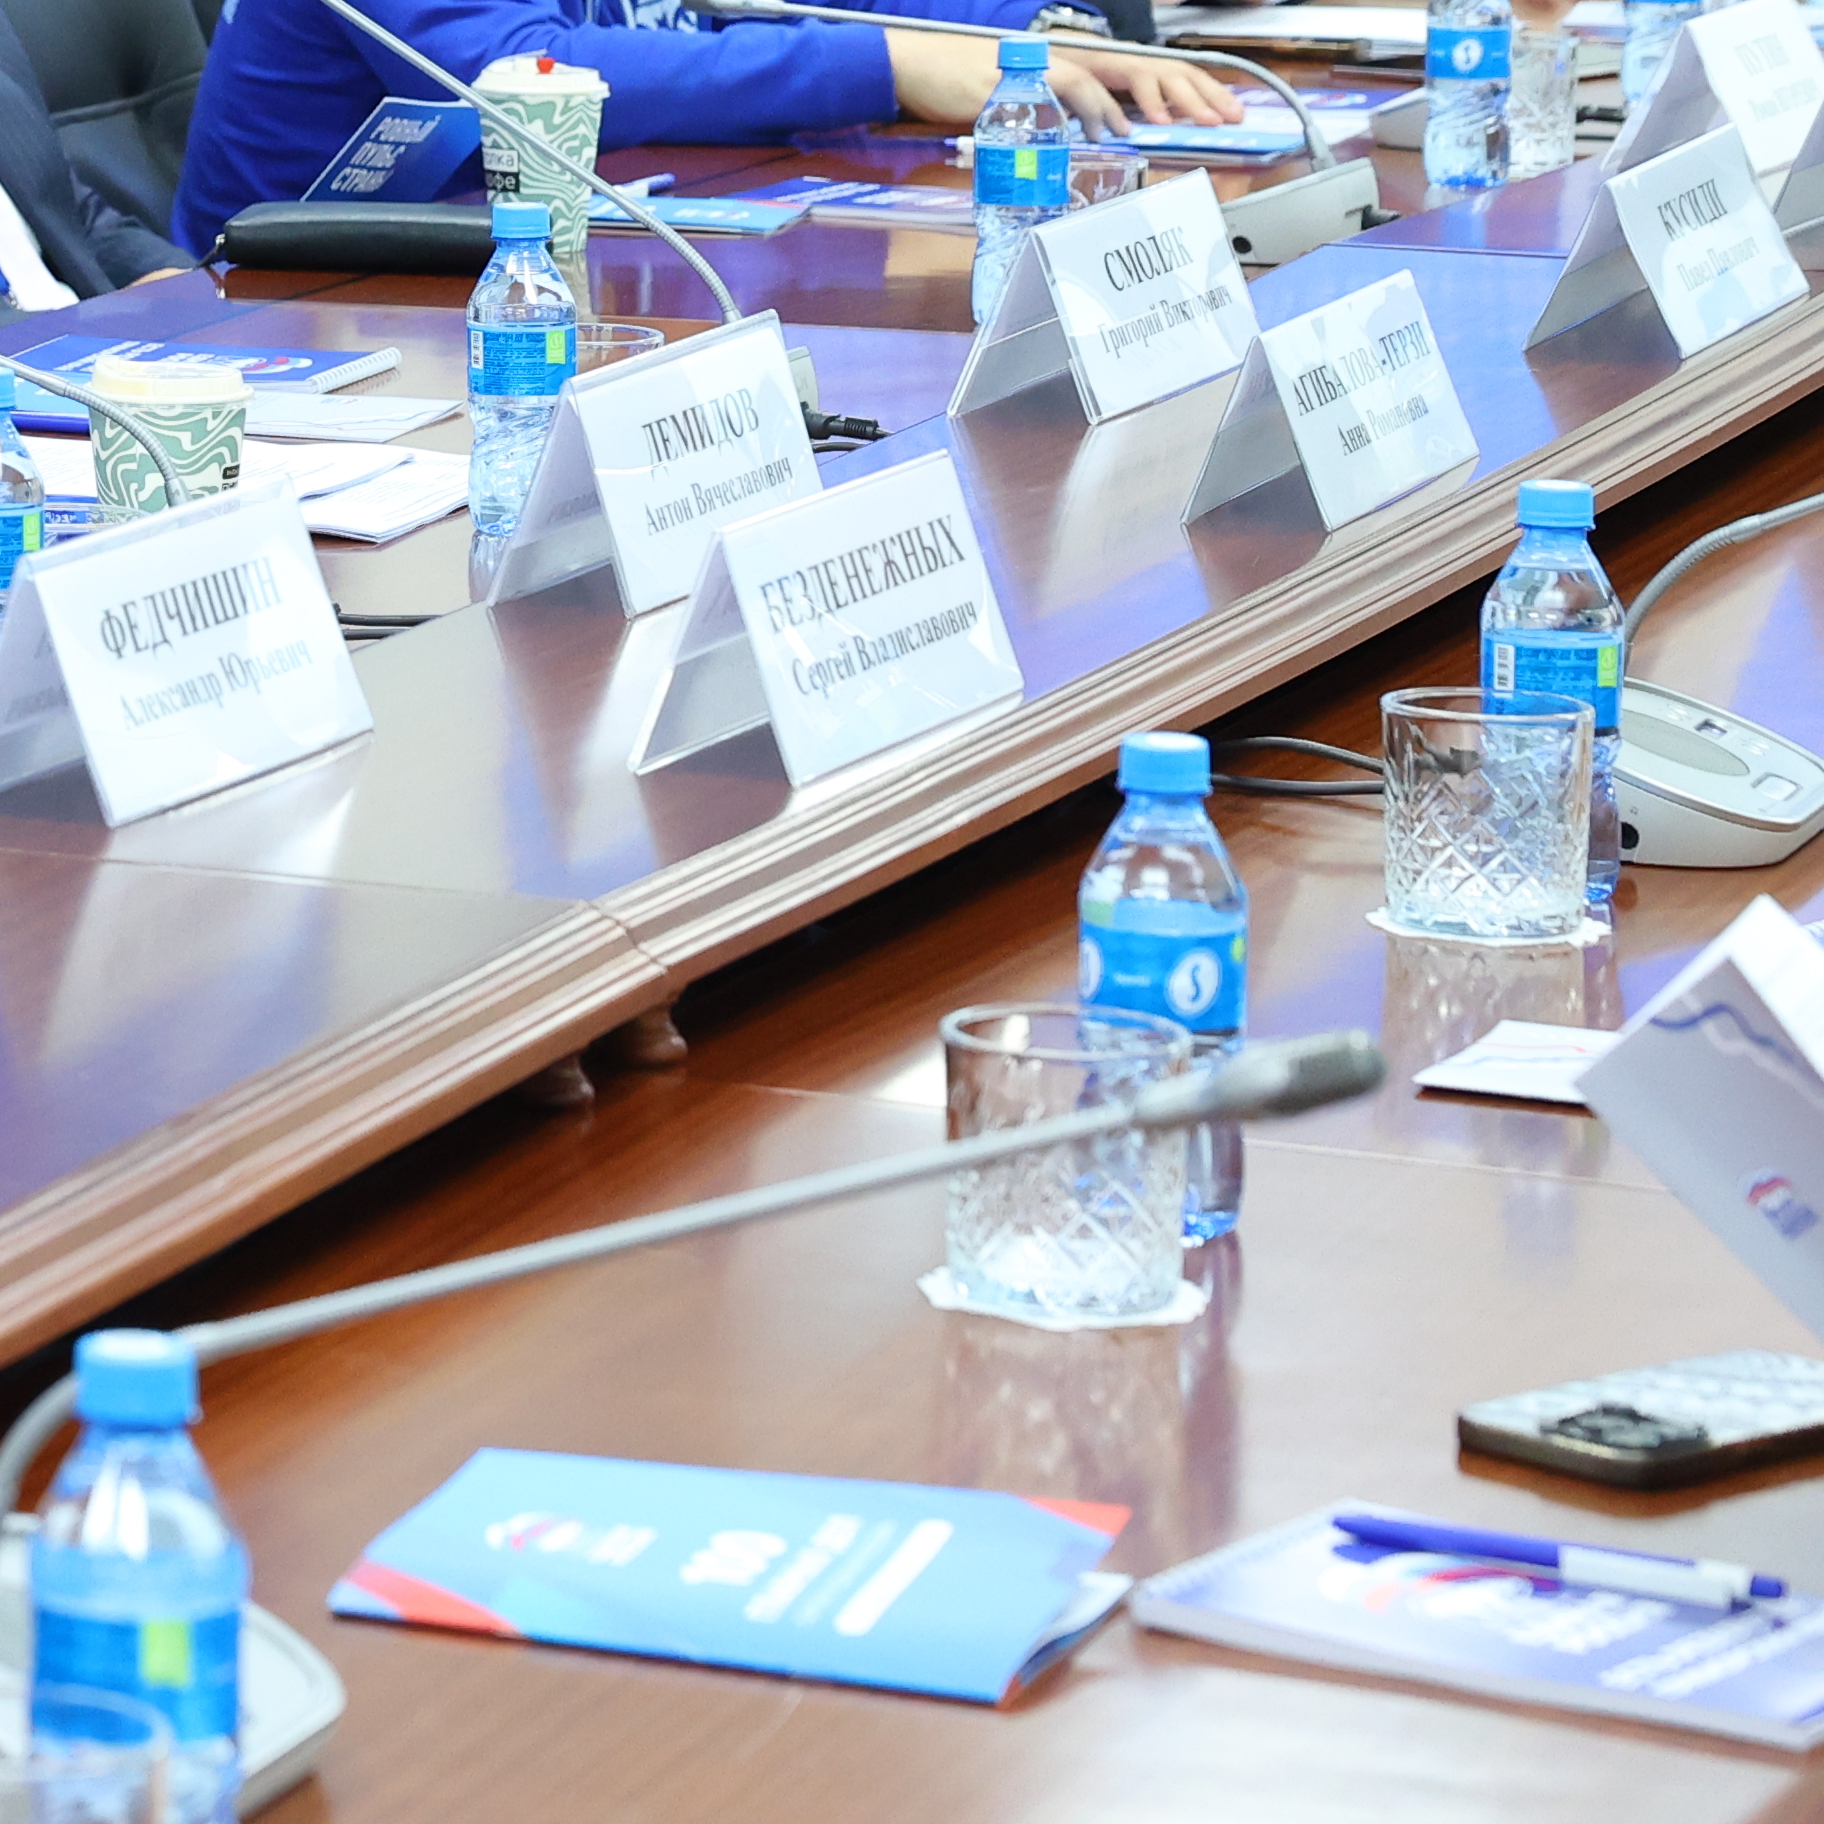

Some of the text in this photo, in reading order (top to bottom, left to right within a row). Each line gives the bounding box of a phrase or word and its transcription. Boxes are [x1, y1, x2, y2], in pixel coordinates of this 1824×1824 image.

[1104, 226, 1194, 292] СМОЛЯК
[1097, 284, 1233, 359] Григорий Викторович
[1292, 320, 1431, 417] АГИБАЛОВА-ТЕРЗИ
[641, 387, 759, 482] ДЕМИДОВ
[1337, 393, 1430, 456] Анна Романовна
[644, 457, 794, 536] Антон Вячеславович
[99, 556, 283, 662] ФЕДЧИШИН
[759, 514, 966, 634] БЕЗДЕНЕЖНЫХ
[118, 639, 313, 732] Александр Юрьевич
[791, 600, 979, 719] Сергей Владиславович
